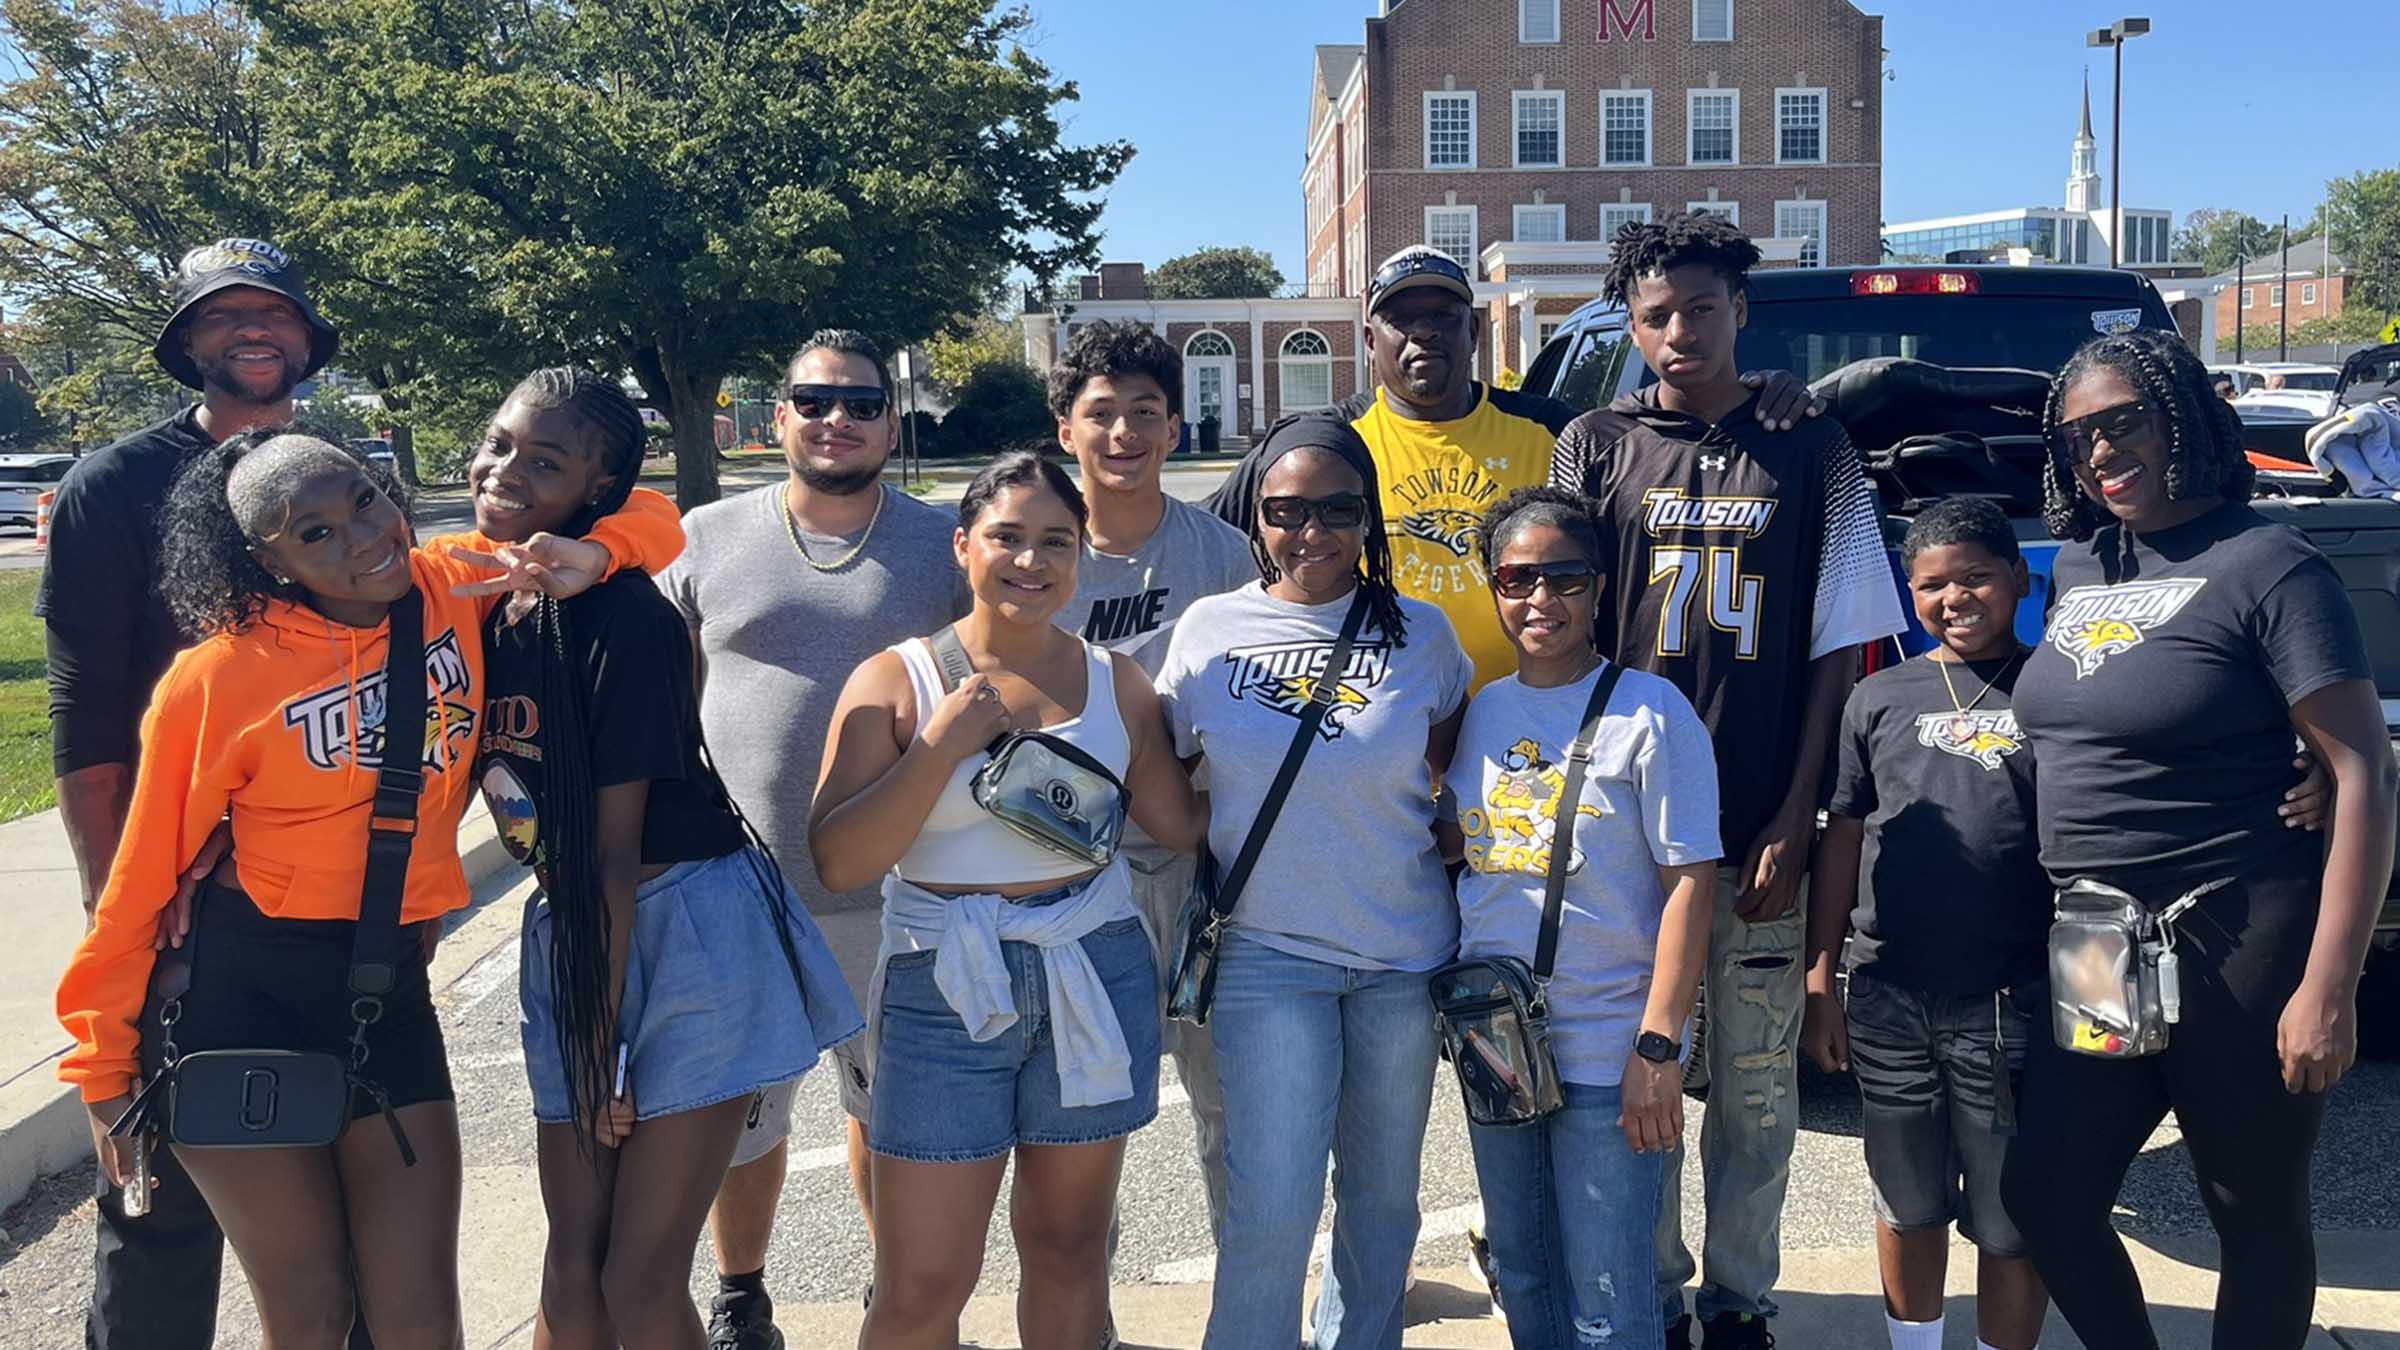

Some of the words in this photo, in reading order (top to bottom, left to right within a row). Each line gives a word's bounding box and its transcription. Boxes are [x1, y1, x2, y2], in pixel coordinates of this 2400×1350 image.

[1596, 0, 1656, 41] M
[1392, 467, 1498, 506] TOWSON
[1641, 488, 1779, 539] TOWSON
[1396, 552, 1489, 593] TIGER
[1084, 588, 1170, 643] NIKE
[1648, 545, 1764, 660] 74
[2046, 577, 2208, 642] TOWSON
[284, 627, 471, 770] TOWON
[1914, 709, 2027, 748] TOSO
[1468, 843, 1551, 877] GERS
